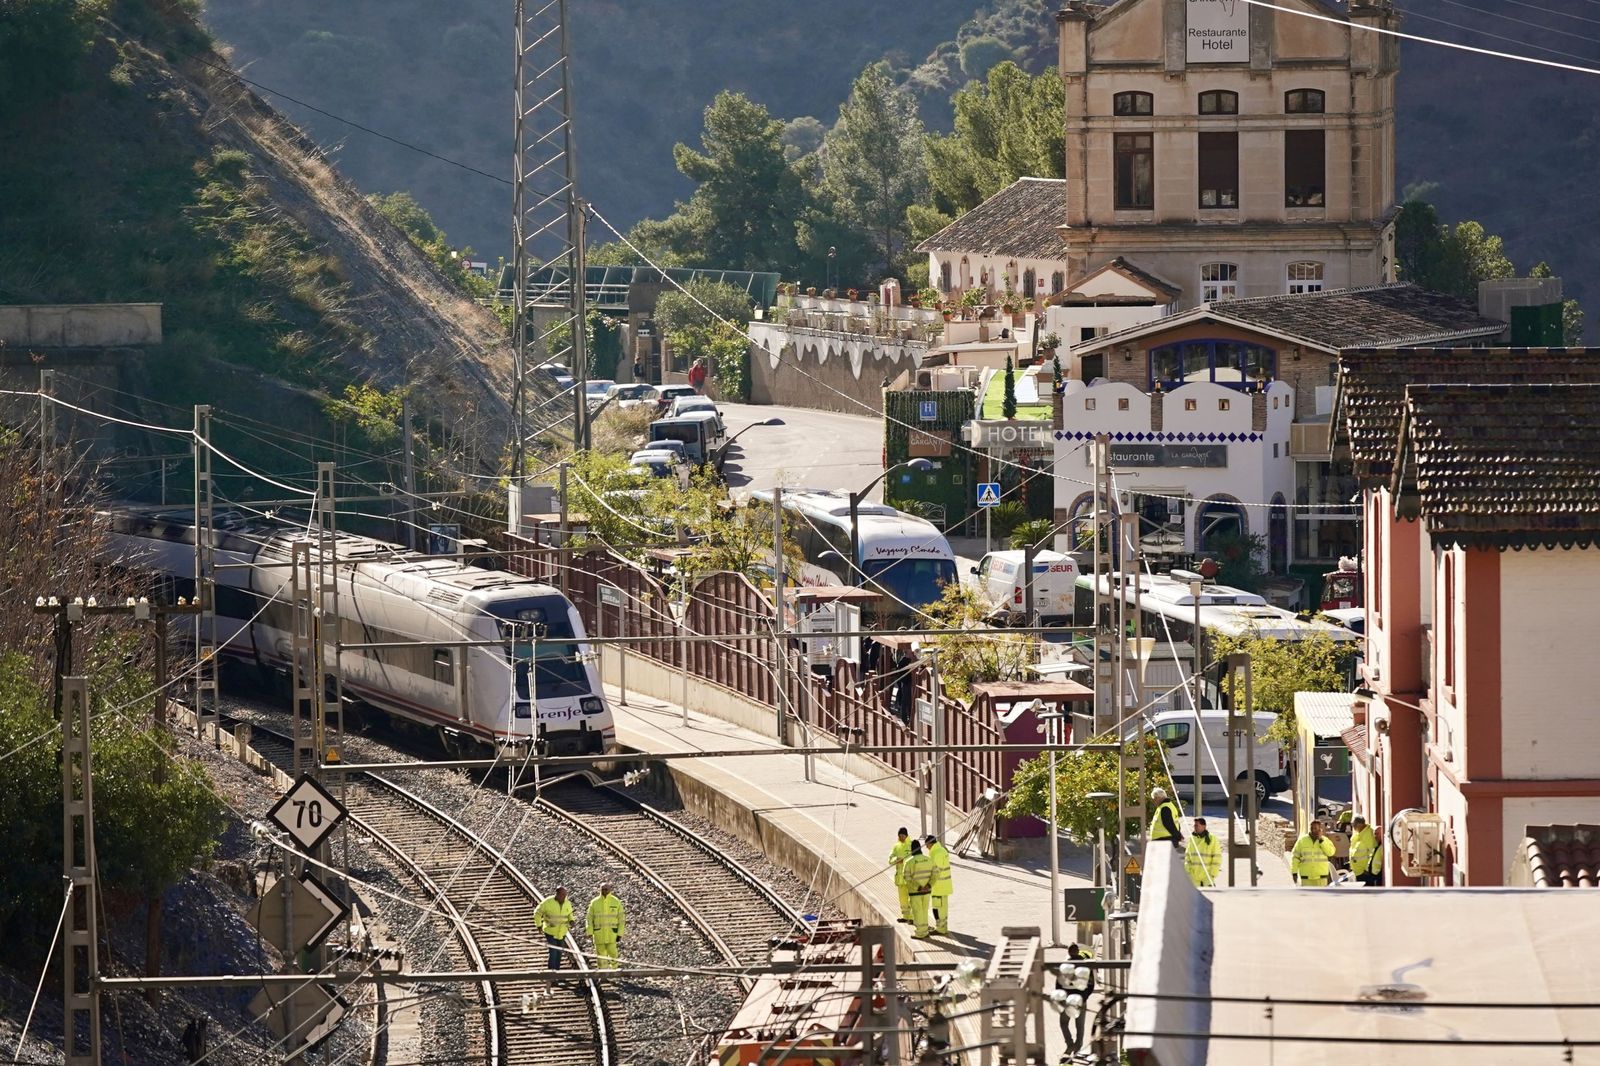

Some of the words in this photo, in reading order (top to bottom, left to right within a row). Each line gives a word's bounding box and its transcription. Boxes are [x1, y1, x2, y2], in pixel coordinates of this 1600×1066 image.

[1188, 28, 1247, 37] Restaurante
[1202, 39, 1233, 50] Hotel
[1108, 452, 1155, 461] staurante
[1050, 564, 1073, 573] SEUR
[540, 706, 582, 721] renfe
[292, 800, 323, 829] 70
[1067, 904, 1077, 921] 2
